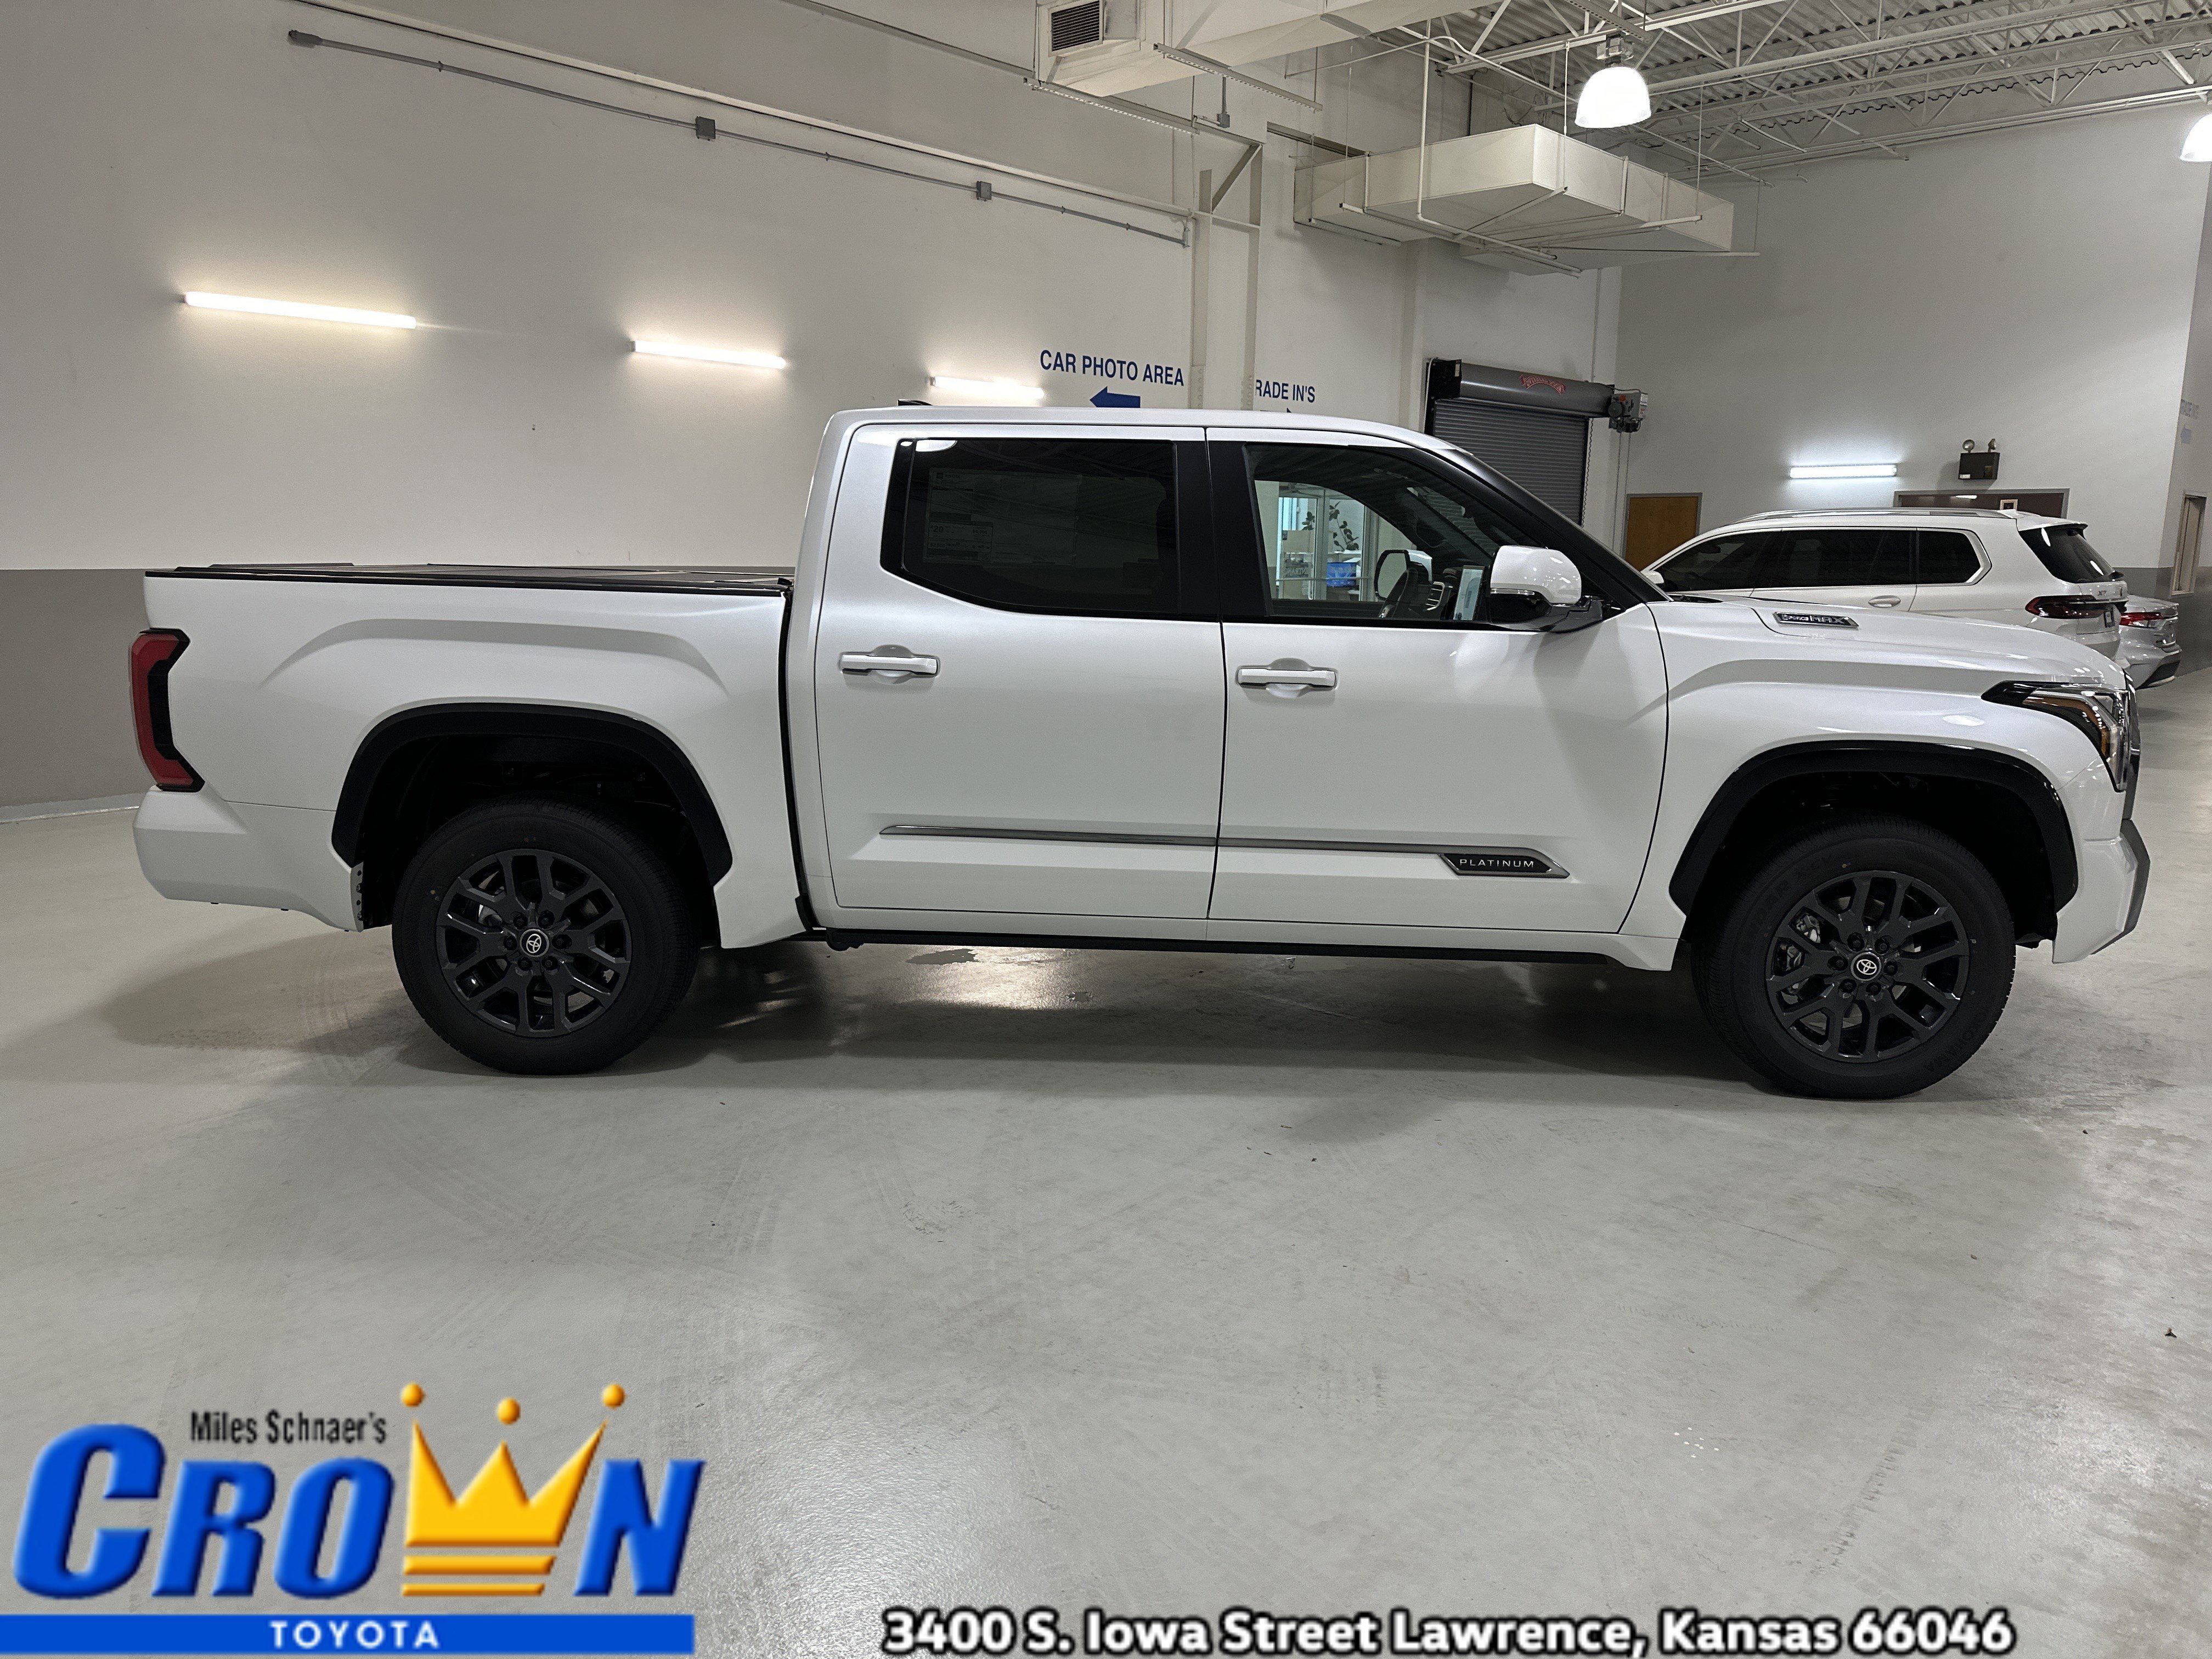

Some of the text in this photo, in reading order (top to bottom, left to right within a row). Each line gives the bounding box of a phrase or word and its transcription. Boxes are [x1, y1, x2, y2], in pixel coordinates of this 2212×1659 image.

[1040, 349, 1184, 387] CAR PHOTO AREA
[1255, 379, 1316, 403] RADE IN'S
[1810, 615, 1845, 624] MAX
[1459, 859, 1534, 868] PLATINUM
